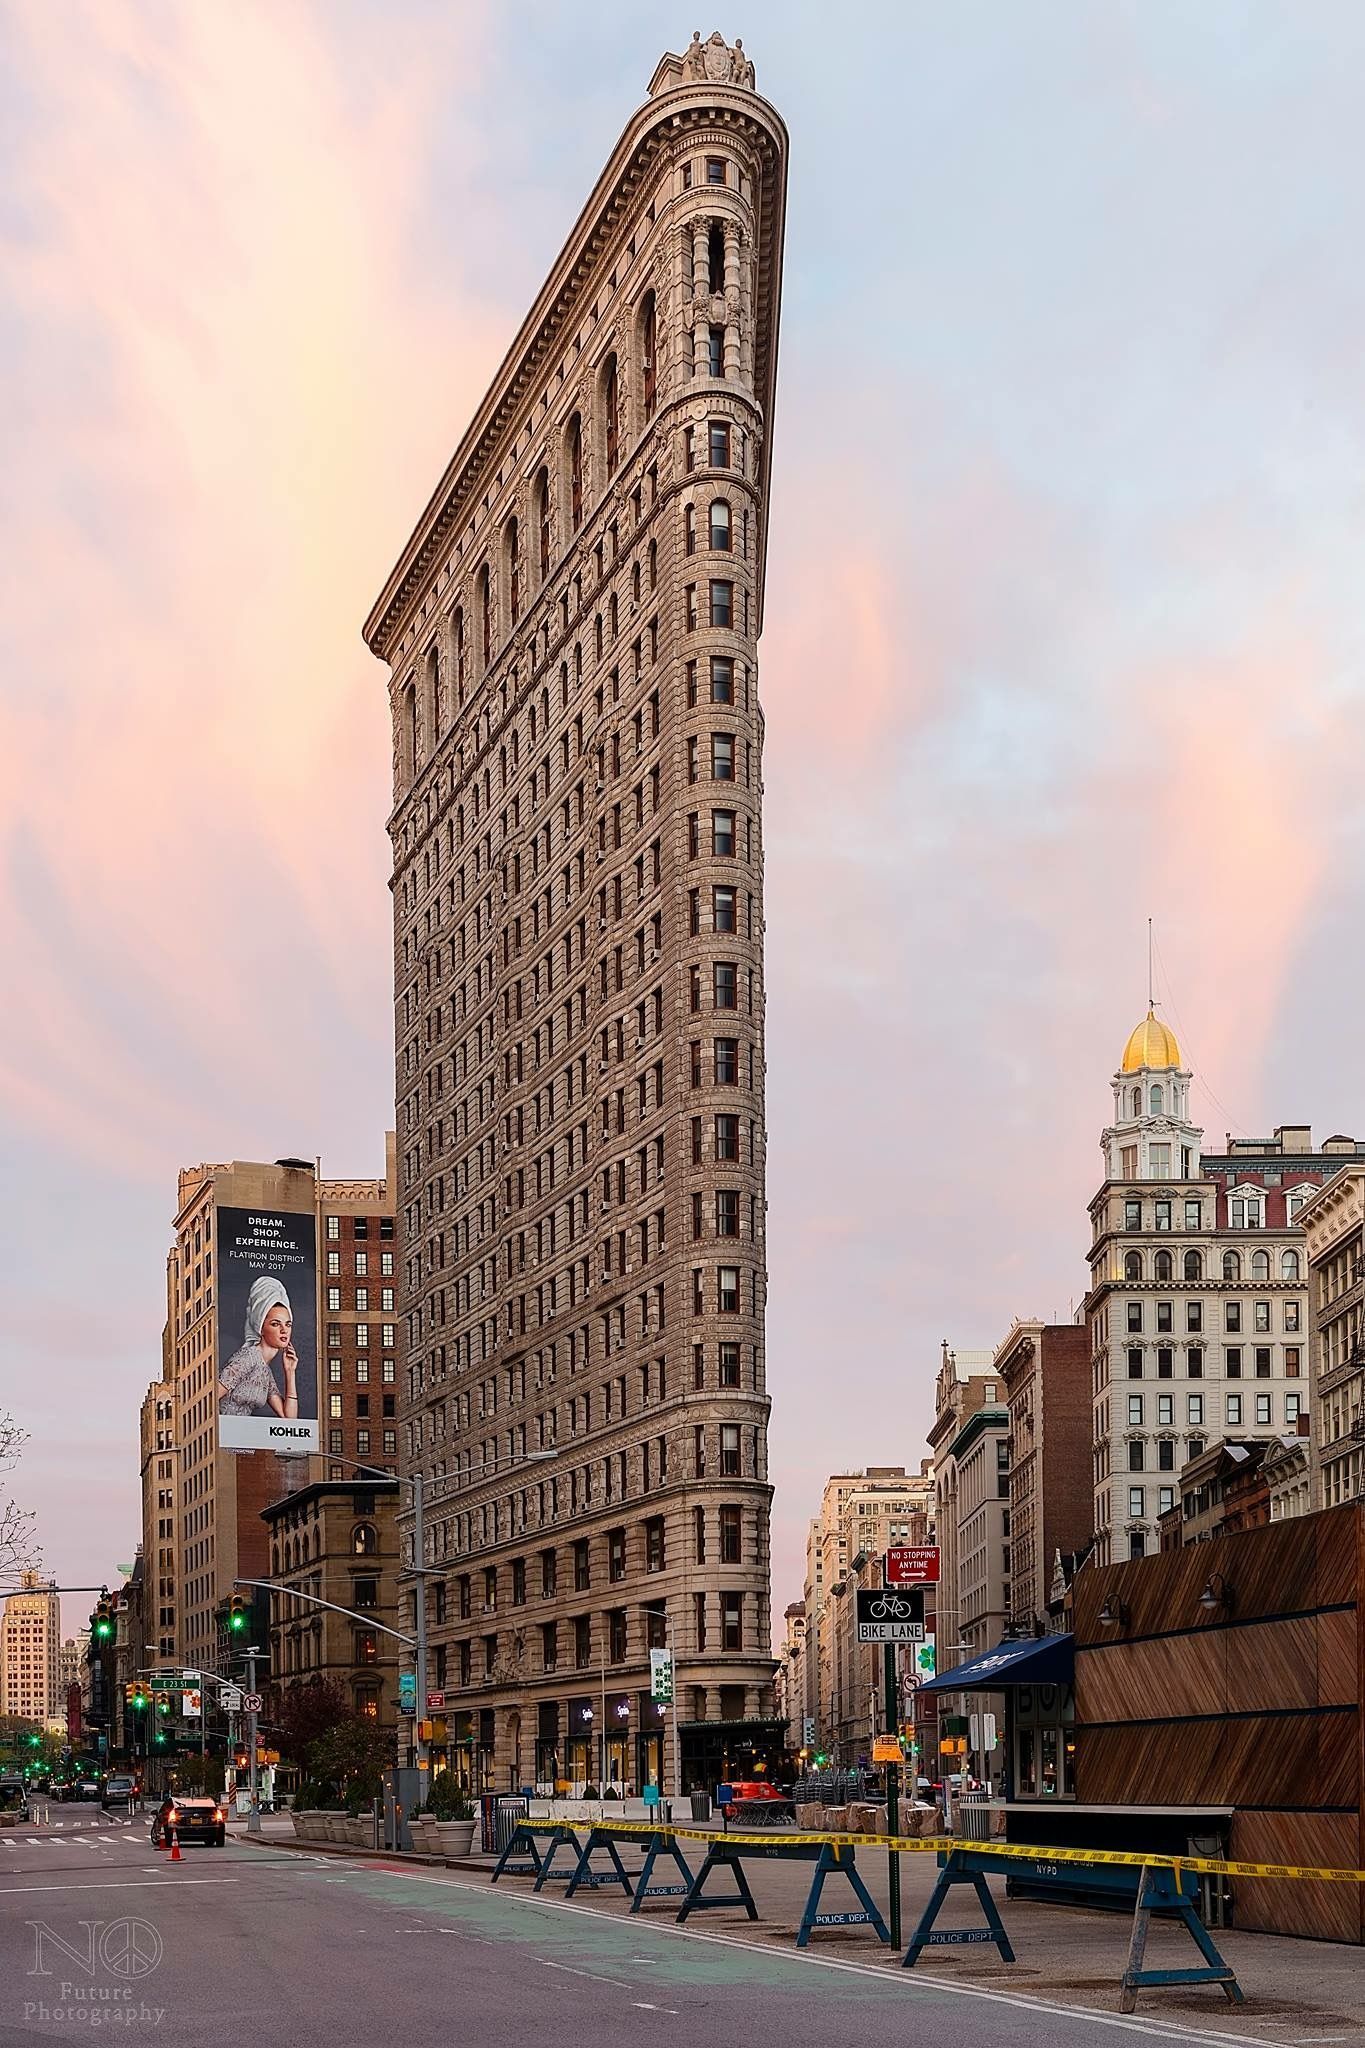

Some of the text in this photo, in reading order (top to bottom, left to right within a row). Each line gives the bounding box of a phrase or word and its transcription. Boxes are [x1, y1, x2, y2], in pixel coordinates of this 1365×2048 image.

[248, 1217, 286, 1228] DREAM.
[253, 1228, 281, 1237] SHOP.
[235, 1238, 299, 1250] EXPERIENCE.
[229, 1250, 305, 1263] FLATIRON DISTRICT
[249, 1261, 286, 1271] MAY 2017
[269, 1426, 311, 1438] KOHLER
[891, 1550, 936, 1560] NO STOPPING
[898, 1560, 929, 1569] ANYTIME
[861, 1624, 921, 1639] BIKE LANE
[1036, 1864, 1058, 1876] NYPD
[1206, 1860, 1229, 1872] CAUTION
[643, 1885, 688, 1895] POLICE DEPT
[816, 1914, 845, 1924] POLICE
[930, 1931, 994, 1944] POLICE DEPT
